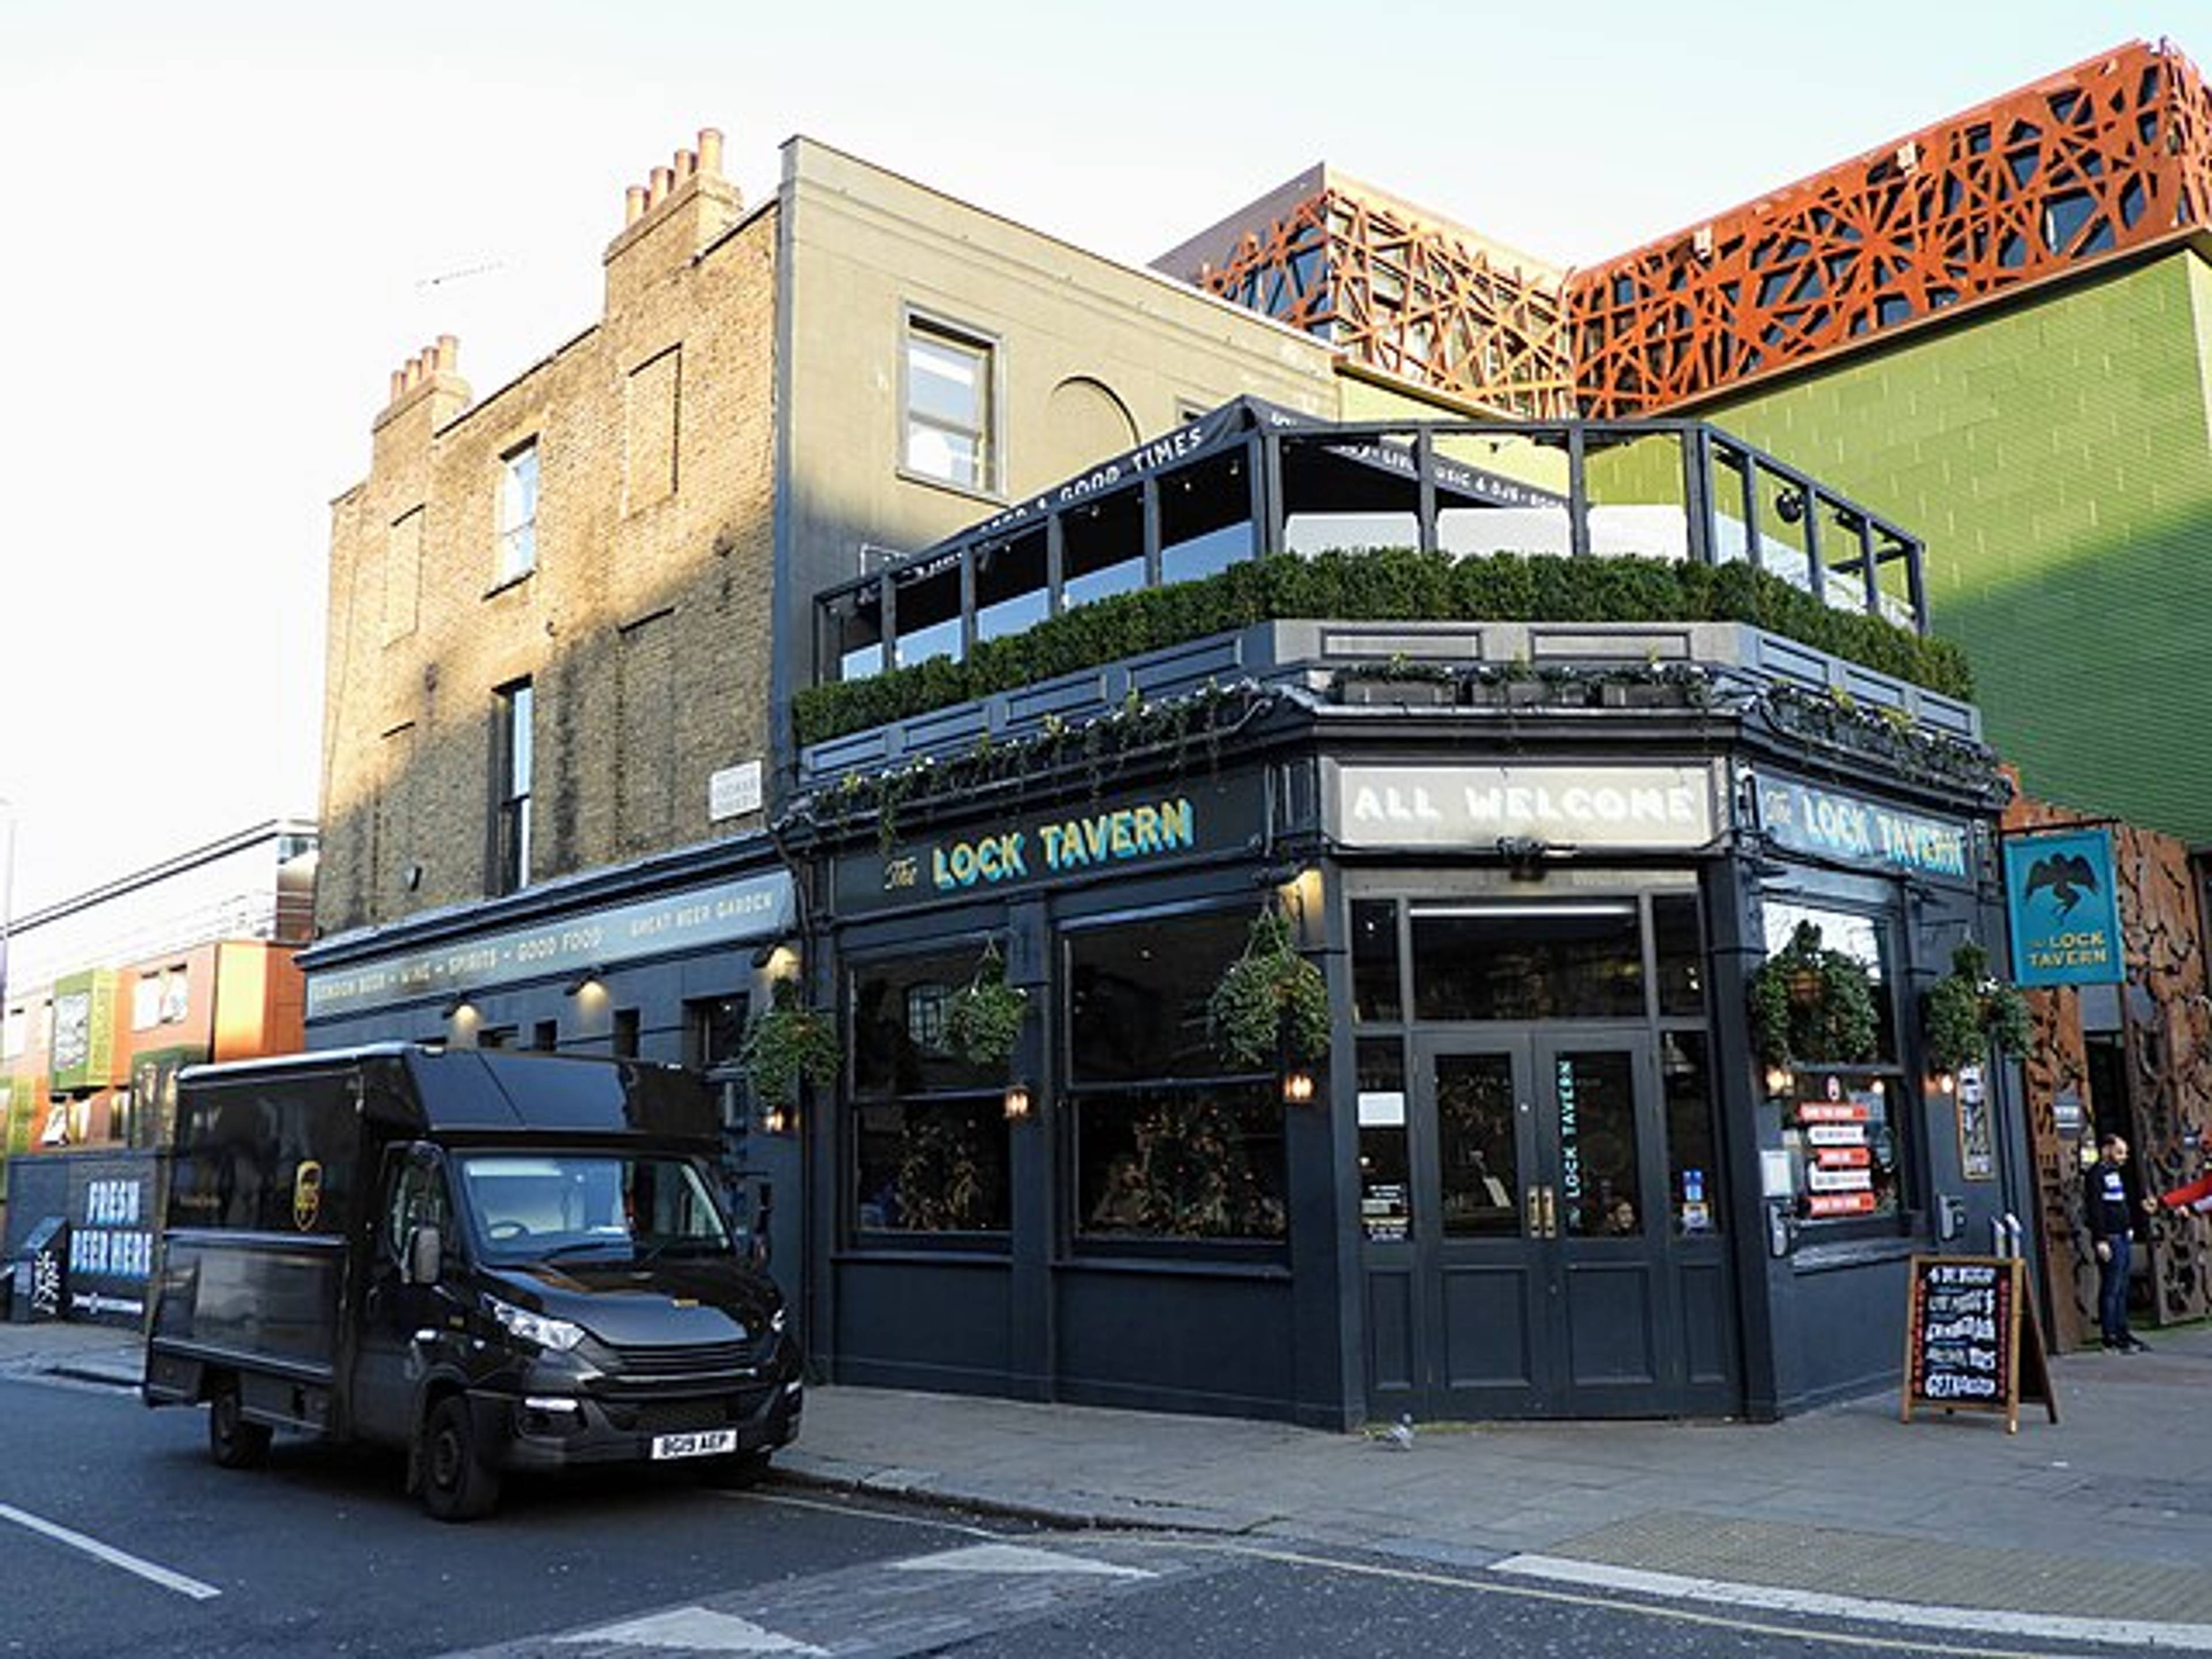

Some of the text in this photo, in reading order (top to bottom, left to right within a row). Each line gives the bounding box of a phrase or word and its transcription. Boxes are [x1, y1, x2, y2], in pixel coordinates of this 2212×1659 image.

[1132, 427, 1202, 472] TIMES
[1354, 785, 1695, 824] ALL WELCOME
[932, 832, 1028, 890] LOCK
[1039, 798, 1195, 869] TAVERN
[1802, 793, 1872, 854] LOCK
[1876, 815, 1965, 876] TAVERN
[716, 891, 772, 919] GARDEN
[448, 948, 497, 974] SPIRITS
[518, 936, 556, 961] GOOD
[562, 926, 604, 952] FOOD
[2028, 949, 2107, 968] TAVERN
[2050, 931, 2105, 949] LOCK
[1558, 1060, 1580, 1198] LOCK TAVERN
[87, 1181, 139, 1225] FRESH
[70, 1230, 153, 1279] BEER HERE
